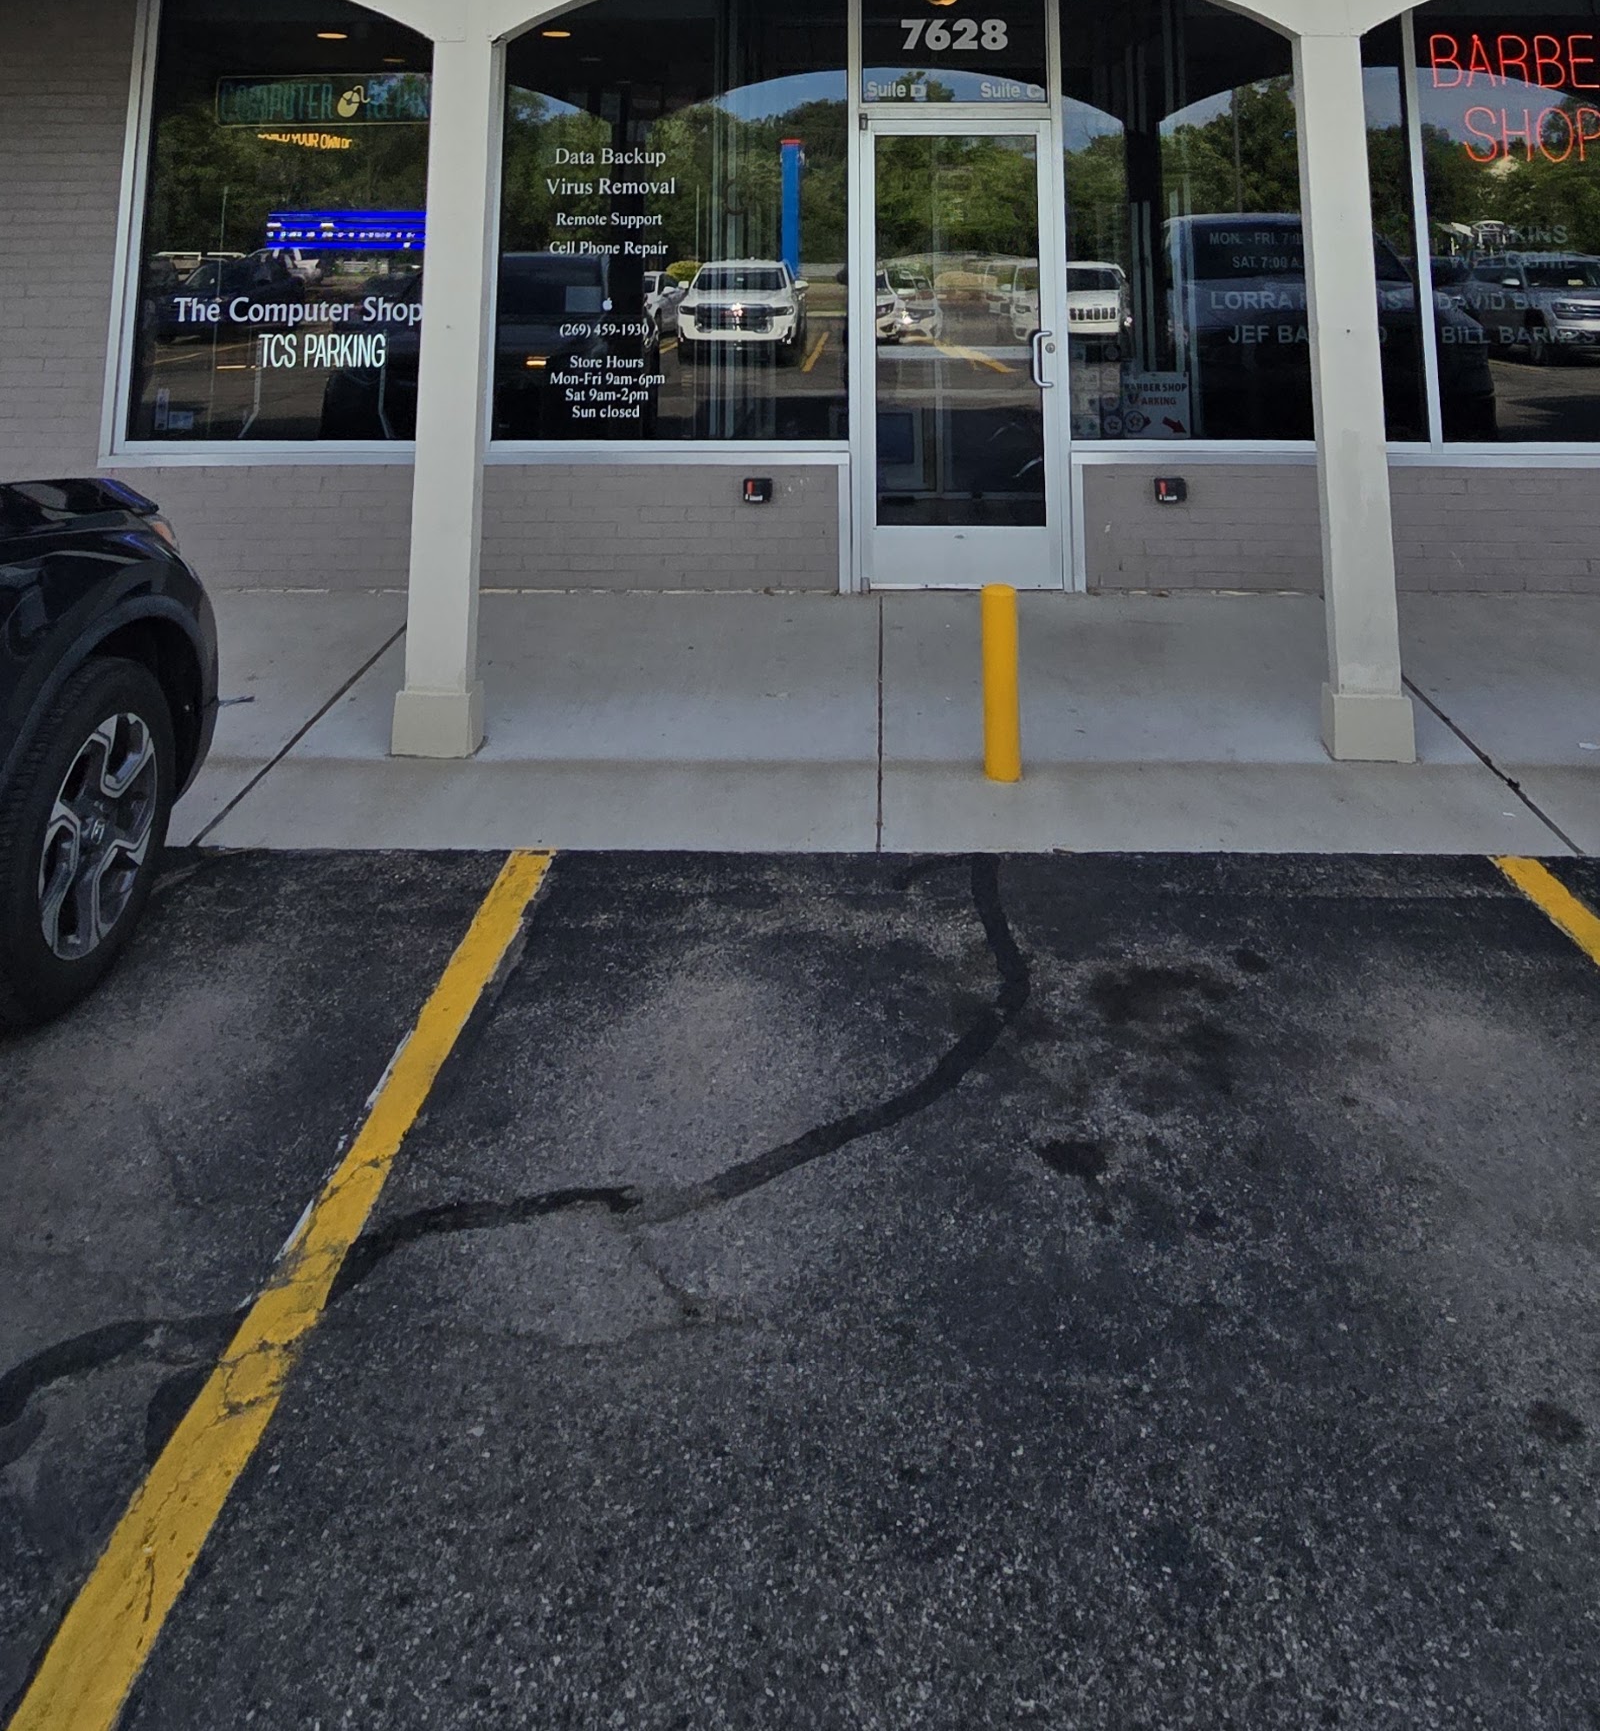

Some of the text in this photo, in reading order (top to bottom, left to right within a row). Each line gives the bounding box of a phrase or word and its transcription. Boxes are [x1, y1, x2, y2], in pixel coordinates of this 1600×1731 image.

[901, 18, 1009, 51] 7628
[866, 81, 927, 98] Suite D
[980, 82, 1045, 98] Suite C
[1464, 106, 1600, 163] SHOP
[555, 147, 667, 166] Data Backup
[546, 178, 675, 195] Virus Removal
[556, 213, 662, 227] Remote Support
[549, 241, 669, 256] Cell Phone Repair
[1210, 290, 1295, 310] LORRA
[173, 297, 221, 322] The
[228, 297, 355, 327] Computer
[559, 324, 649, 338] (269) 459-1930
[1227, 325, 1270, 344] JEF
[1441, 326, 1490, 345] BILL
[258, 333, 387, 368] TCS PARKING
[569, 356, 644, 368] Store Hours
[549, 372, 665, 388] Mon-Fri 9am-6pm
[1162, 383, 1187, 392] SHOP
[565, 388, 649, 403] Sat 9am-2pm
[1127, 395, 1177, 406] ARKING
[572, 405, 640, 418] Sun closed
